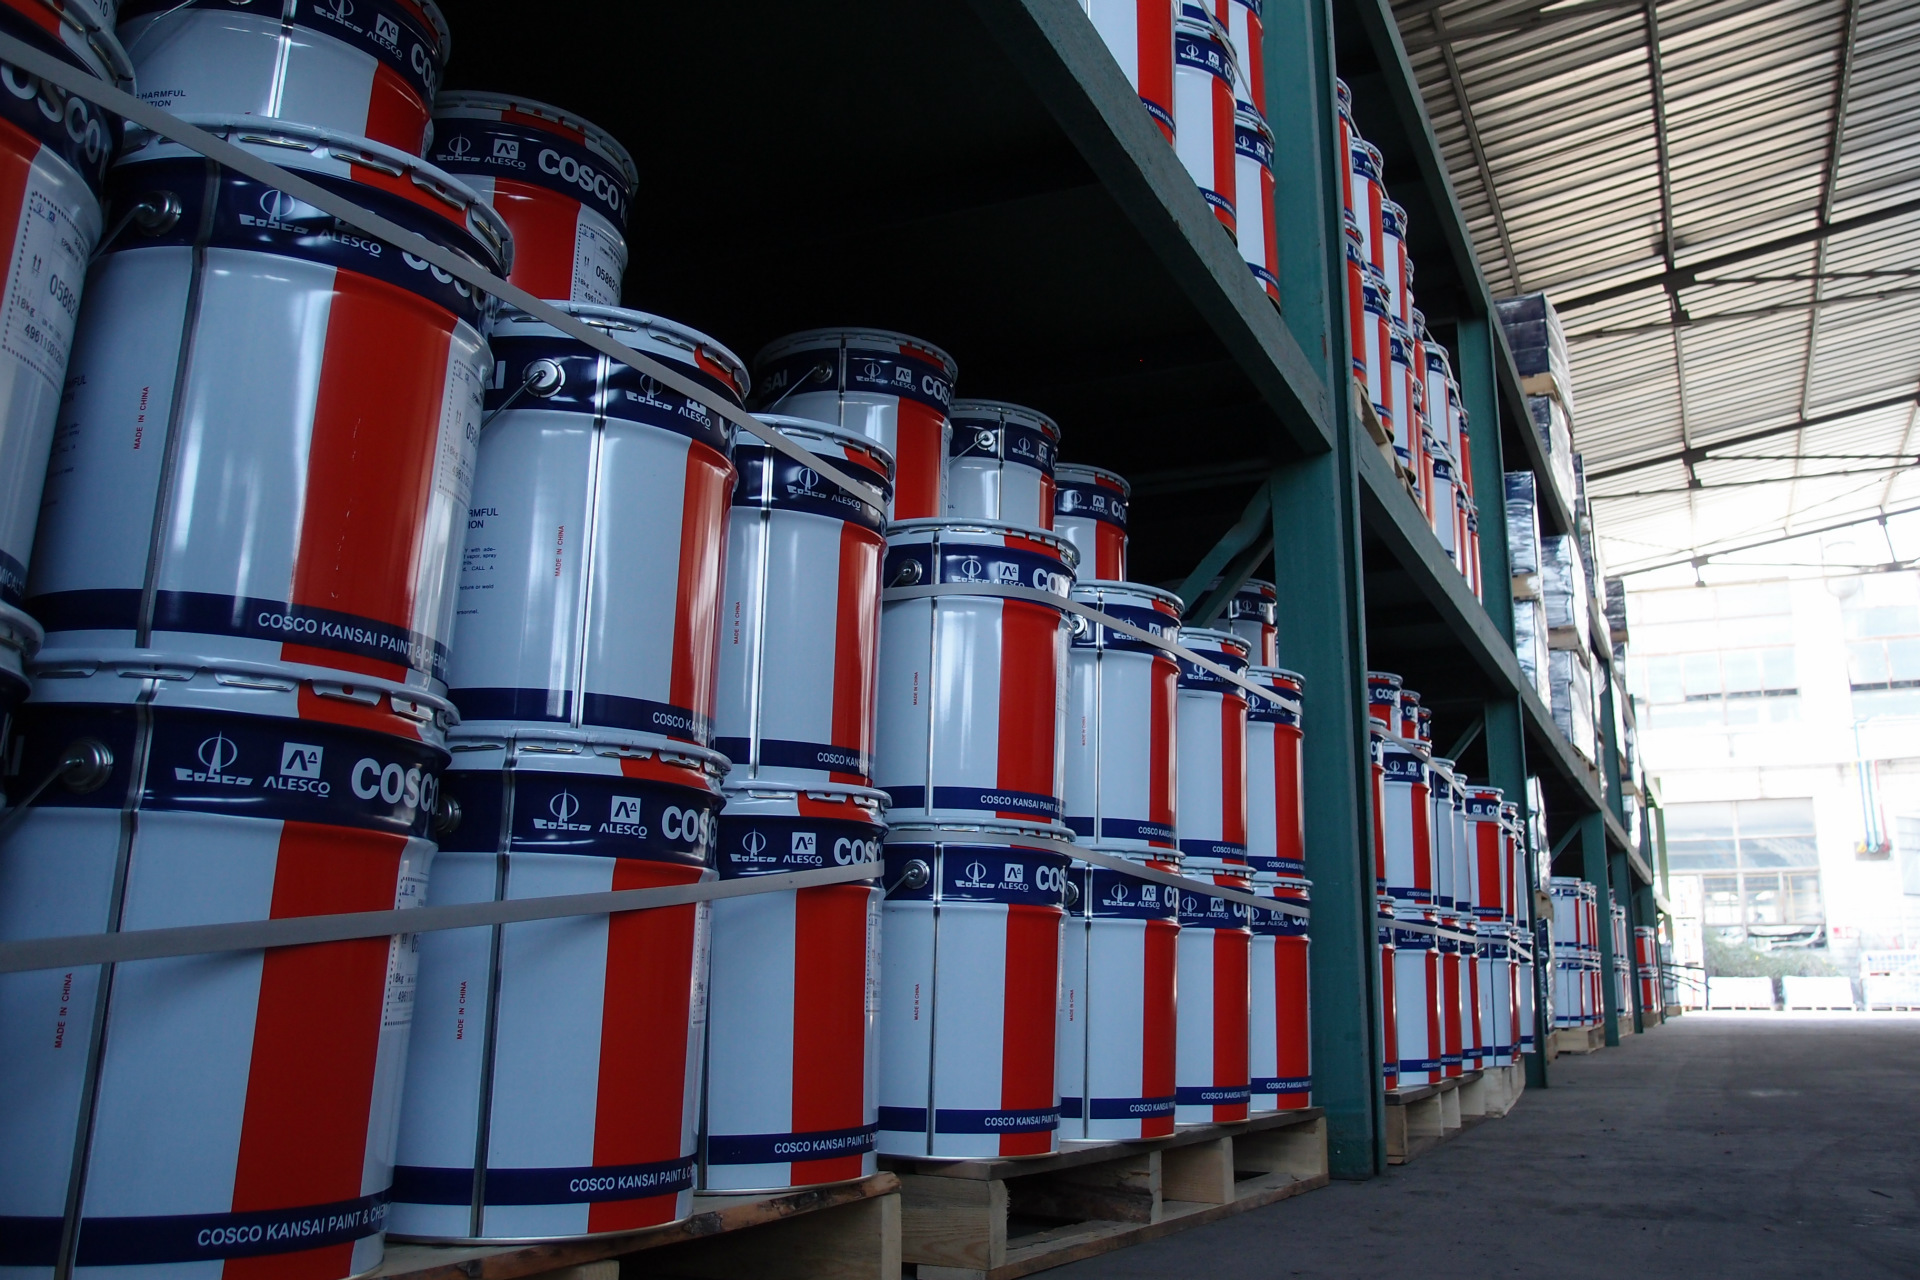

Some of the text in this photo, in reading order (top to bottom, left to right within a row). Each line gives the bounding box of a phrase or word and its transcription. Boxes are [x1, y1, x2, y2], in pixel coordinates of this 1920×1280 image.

[366, 30, 403, 61] ALESCO
[140, 90, 187, 99] HARMFUL
[437, 152, 481, 163] COSCO
[484, 156, 527, 171] ALESCO
[537, 148, 619, 211] COSCO
[238, 213, 309, 235] COSCO
[317, 228, 383, 258] ALESCO
[15, 294, 36, 319] 18kg
[855, 374, 889, 385] COSCO
[890, 379, 917, 393] ALESCO
[625, 389, 673, 411] COSCO
[133, 386, 150, 450] MADE IN CHINA
[677, 405, 711, 430] ALESCO
[786, 483, 827, 499] COSCO
[831, 494, 861, 511] ALESCO
[554, 525, 565, 577] MADE IN CHINA
[258, 612, 317, 634] COSCO
[320, 622, 377, 647] KANSAI
[380, 635, 414, 657] PAINT
[652, 711, 685, 729] COSCO
[817, 752, 845, 765] COSCO
[173, 765, 254, 786] COSCO
[262, 775, 331, 798] ALESCO
[980, 794, 1011, 806] COSCO
[1012, 797, 1039, 809] KANSAI
[1039, 801, 1055, 813] PAINT
[533, 816, 592, 831] COSCO
[599, 822, 648, 839] ALESCO
[1137, 826, 1158, 836] COSCO
[1212, 845, 1231, 854] COSCO
[729, 851, 777, 864] COSCO
[782, 854, 823, 867] ALESCO
[1266, 860, 1285, 869] COSCO
[954, 879, 996, 890] COSCO
[997, 881, 1029, 893] ALESCO
[1102, 898, 1136, 908] COSCO
[1137, 900, 1161, 911] ALESCO
[1205, 911, 1230, 920] ALESCO
[1267, 919, 1289, 929] ALESCO
[54, 972, 73, 1049] MADE IN CHINA
[456, 980, 468, 1041] MADE IN CHINA
[1266, 1082, 1287, 1090] COSCO
[1200, 1092, 1224, 1101] COSCO
[1129, 1104, 1152, 1113] COSCO
[984, 1117, 1015, 1127] COSCO
[1016, 1115, 1041, 1126] KANSAI
[774, 1142, 811, 1155] COSCO
[812, 1137, 846, 1153] KANSAI
[846, 1134, 865, 1147] PAINT
[568, 1176, 616, 1193] COSCO
[617, 1171, 658, 1190] KANSAI
[659, 1167, 682, 1185] PAINT
[196, 1208, 369, 1247] COSCO KANSAI PAINT &
